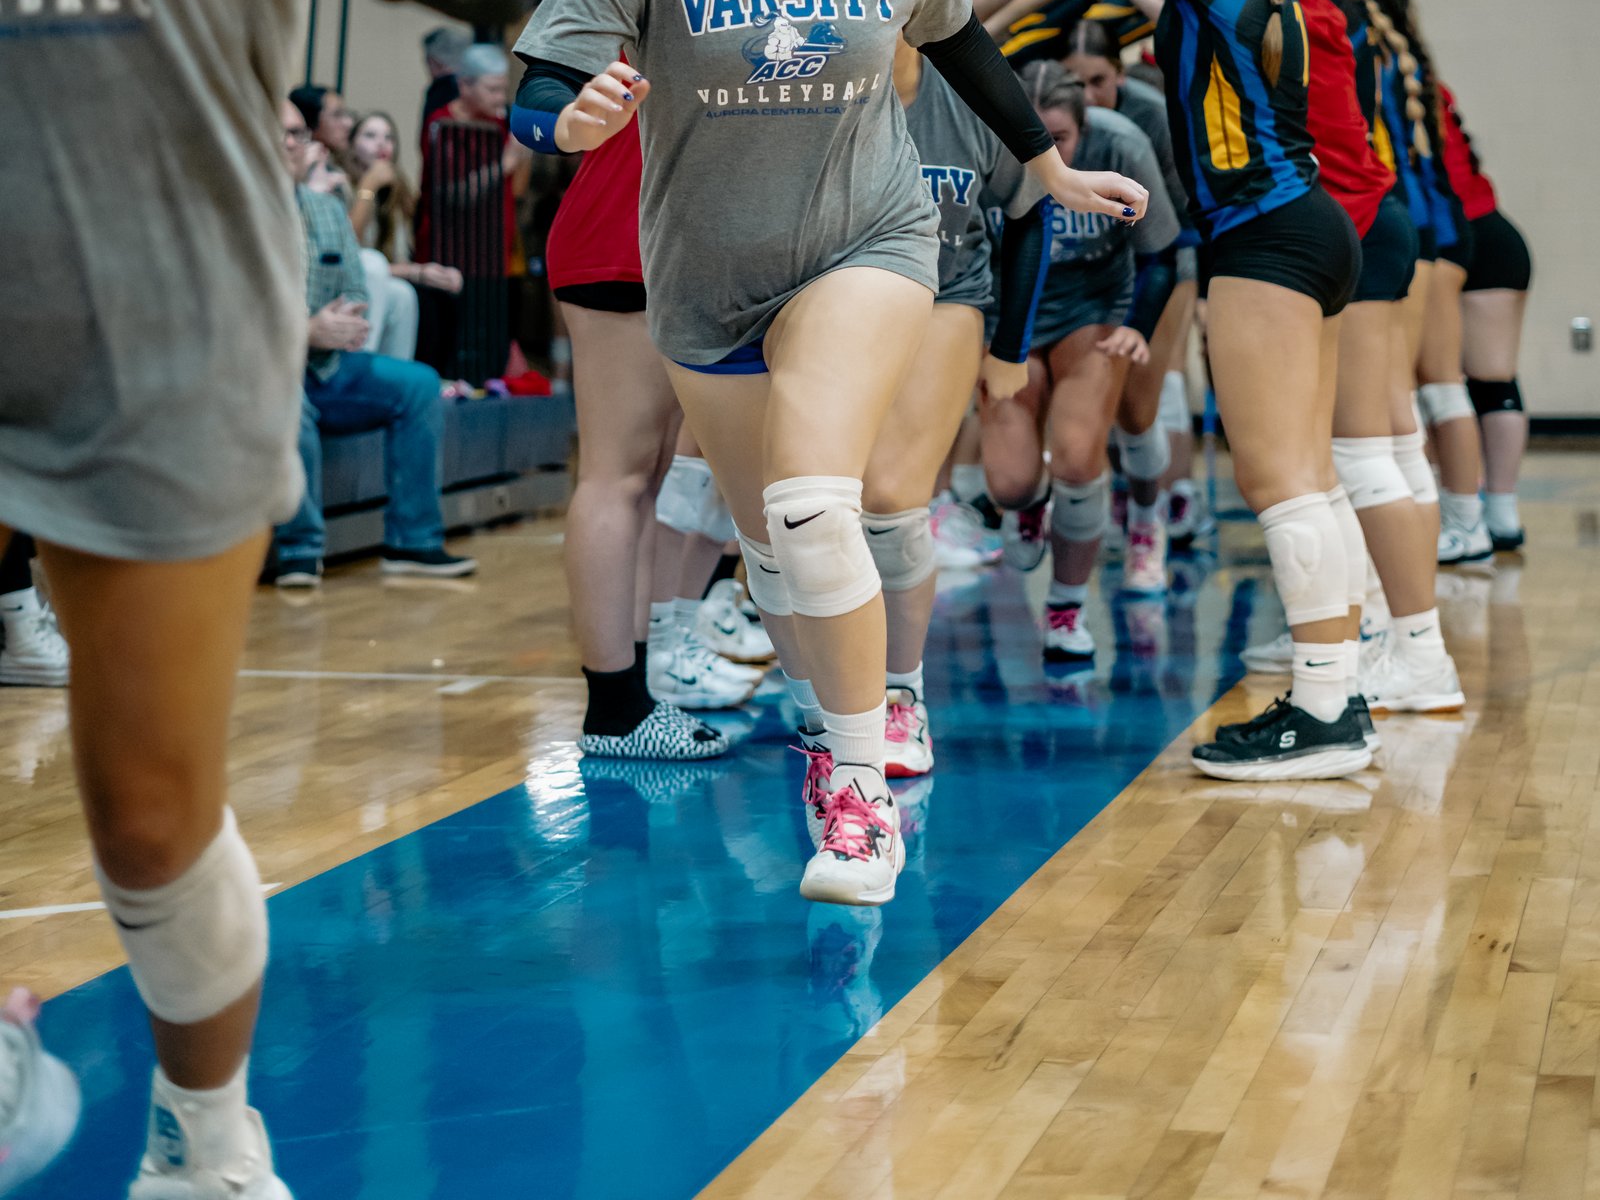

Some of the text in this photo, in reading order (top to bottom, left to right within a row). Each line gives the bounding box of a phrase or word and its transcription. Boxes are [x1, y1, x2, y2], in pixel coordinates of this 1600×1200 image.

[746, 55, 827, 85] ACC
[697, 73, 880, 106] VOLLEYBALL
[705, 103, 759, 120] AURORA
[761, 105, 822, 116] CENTRAL
